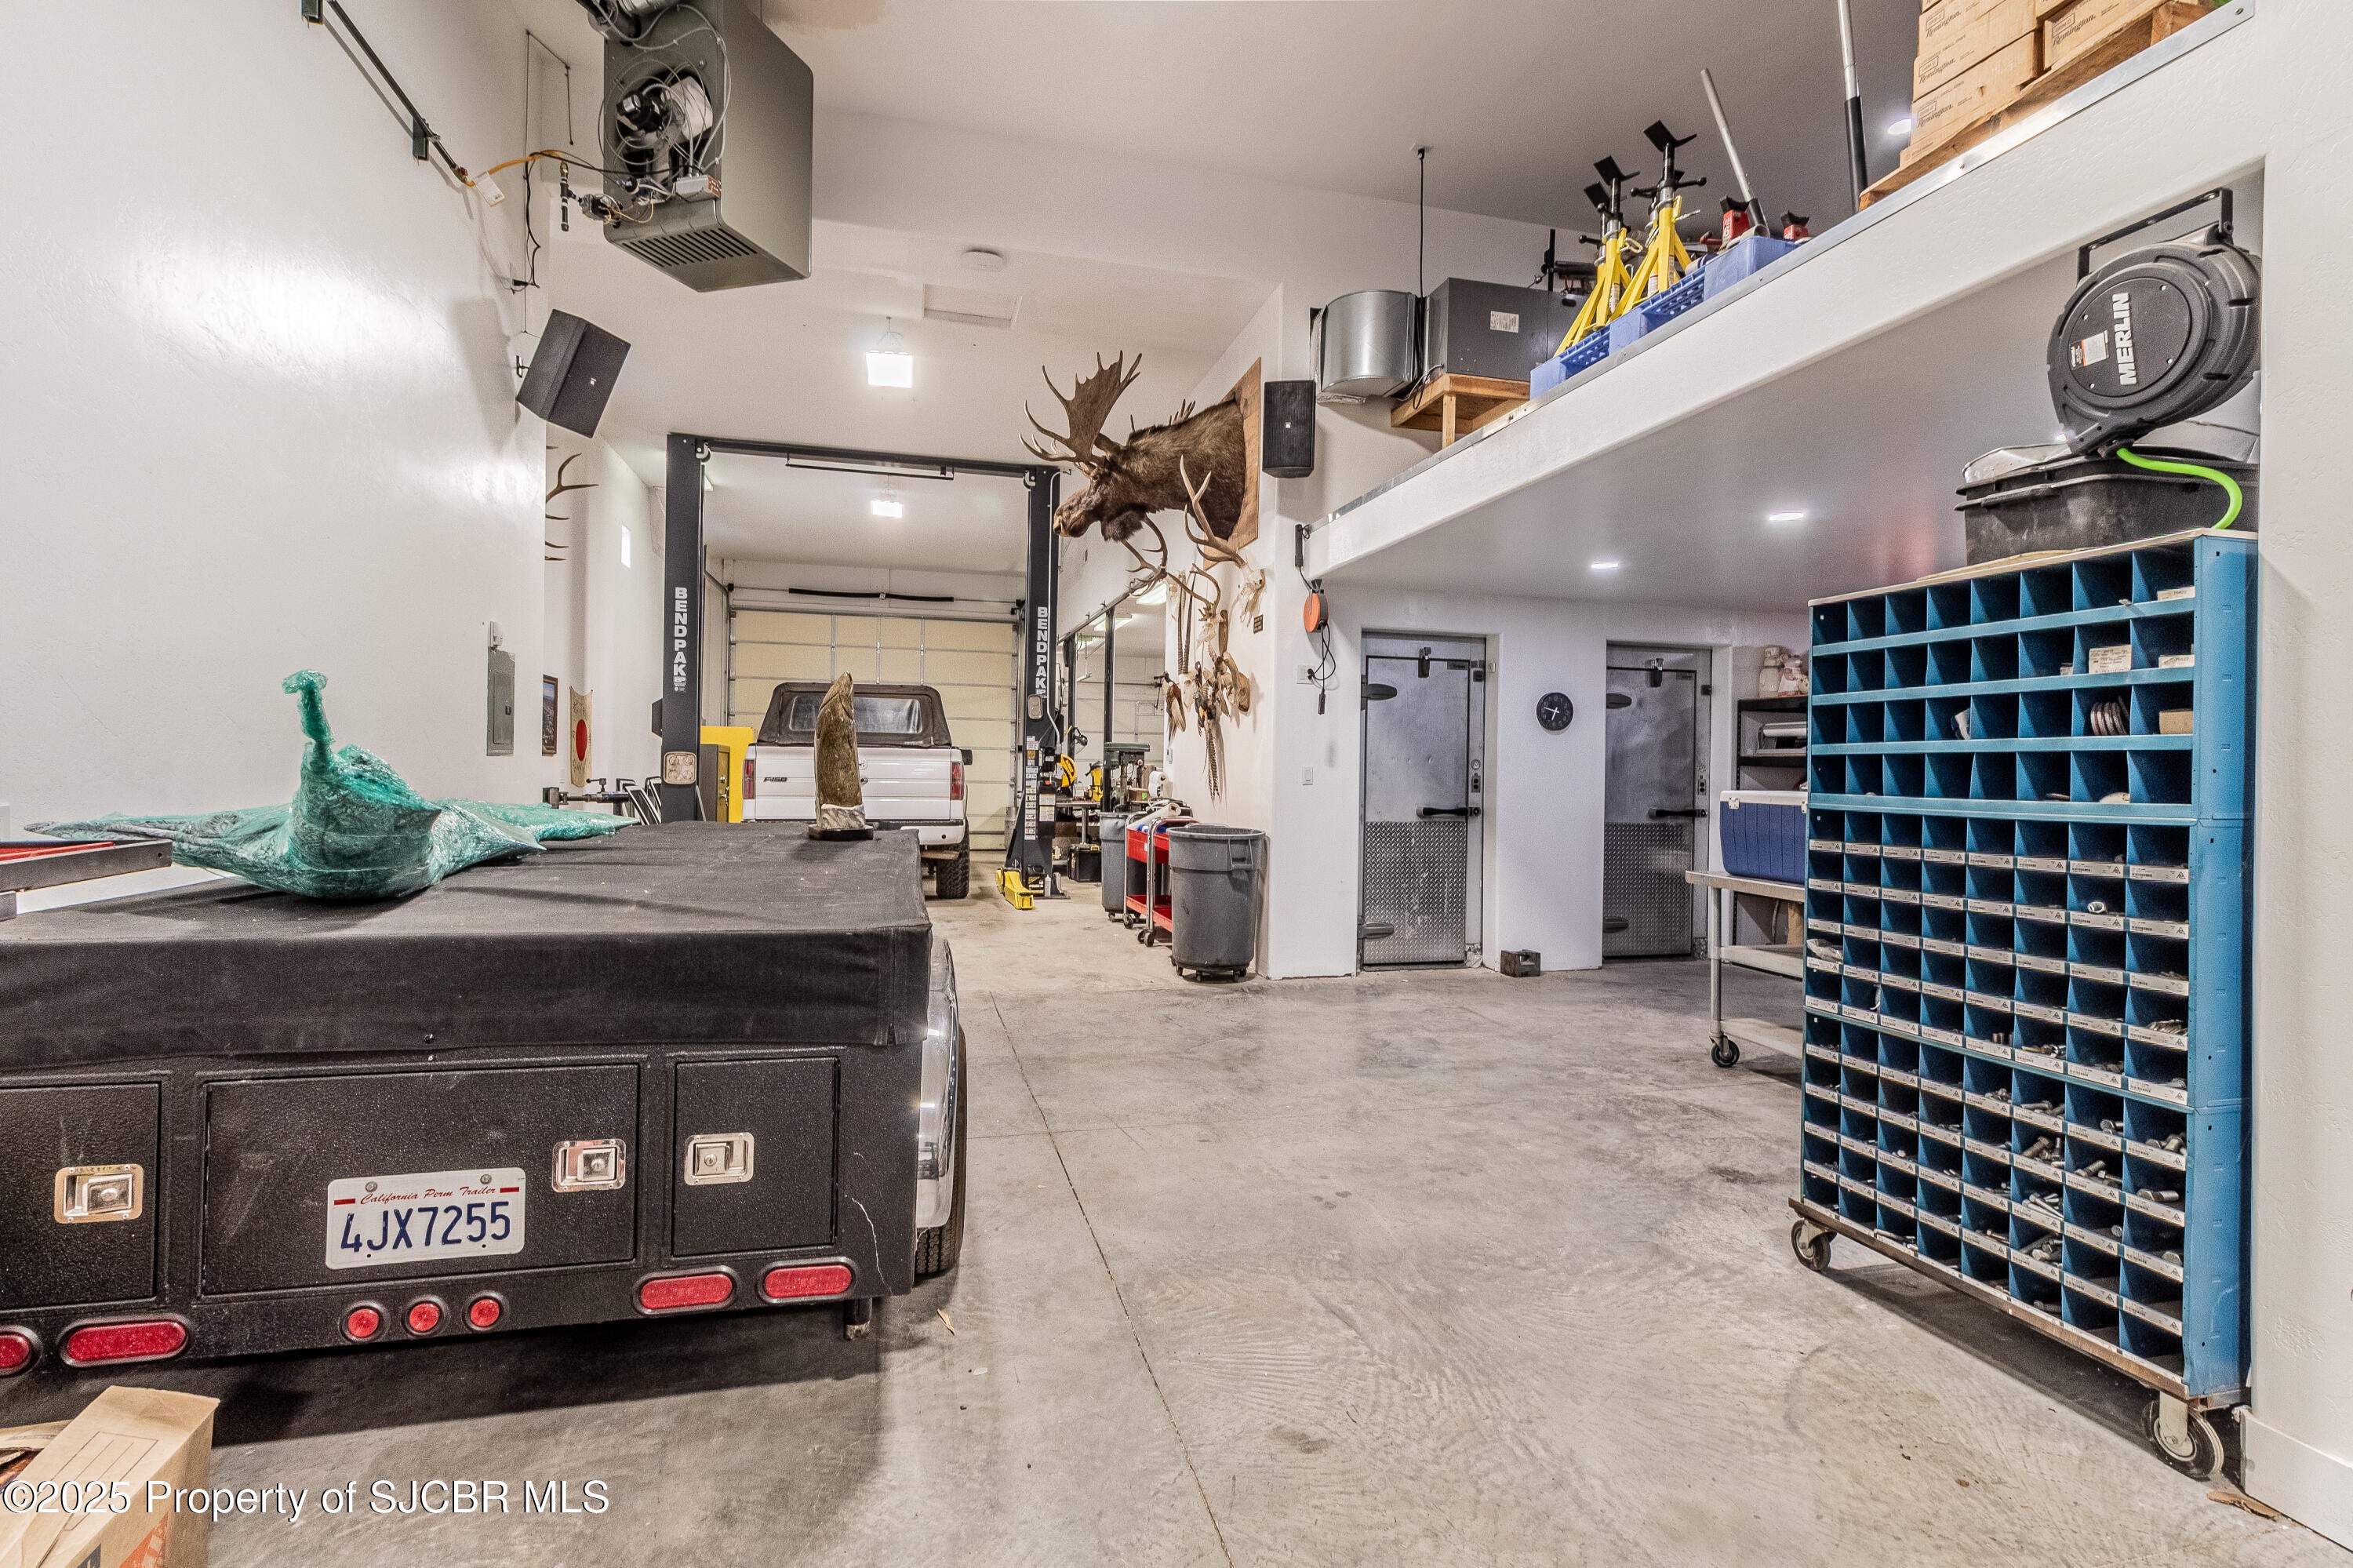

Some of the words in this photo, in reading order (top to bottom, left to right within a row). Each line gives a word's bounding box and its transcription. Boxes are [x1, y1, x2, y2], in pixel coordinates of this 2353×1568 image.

[2112, 292, 2137, 385] MERLIN
[673, 587, 688, 676] BENDPAK
[1035, 606, 1049, 689] BENDPAK
[340, 1201, 511, 1253] 4JX7255
[360, 1192, 418, 1206] California
[424, 1188, 453, 1199] Perm
[460, 1186, 496, 1196] Trailer
